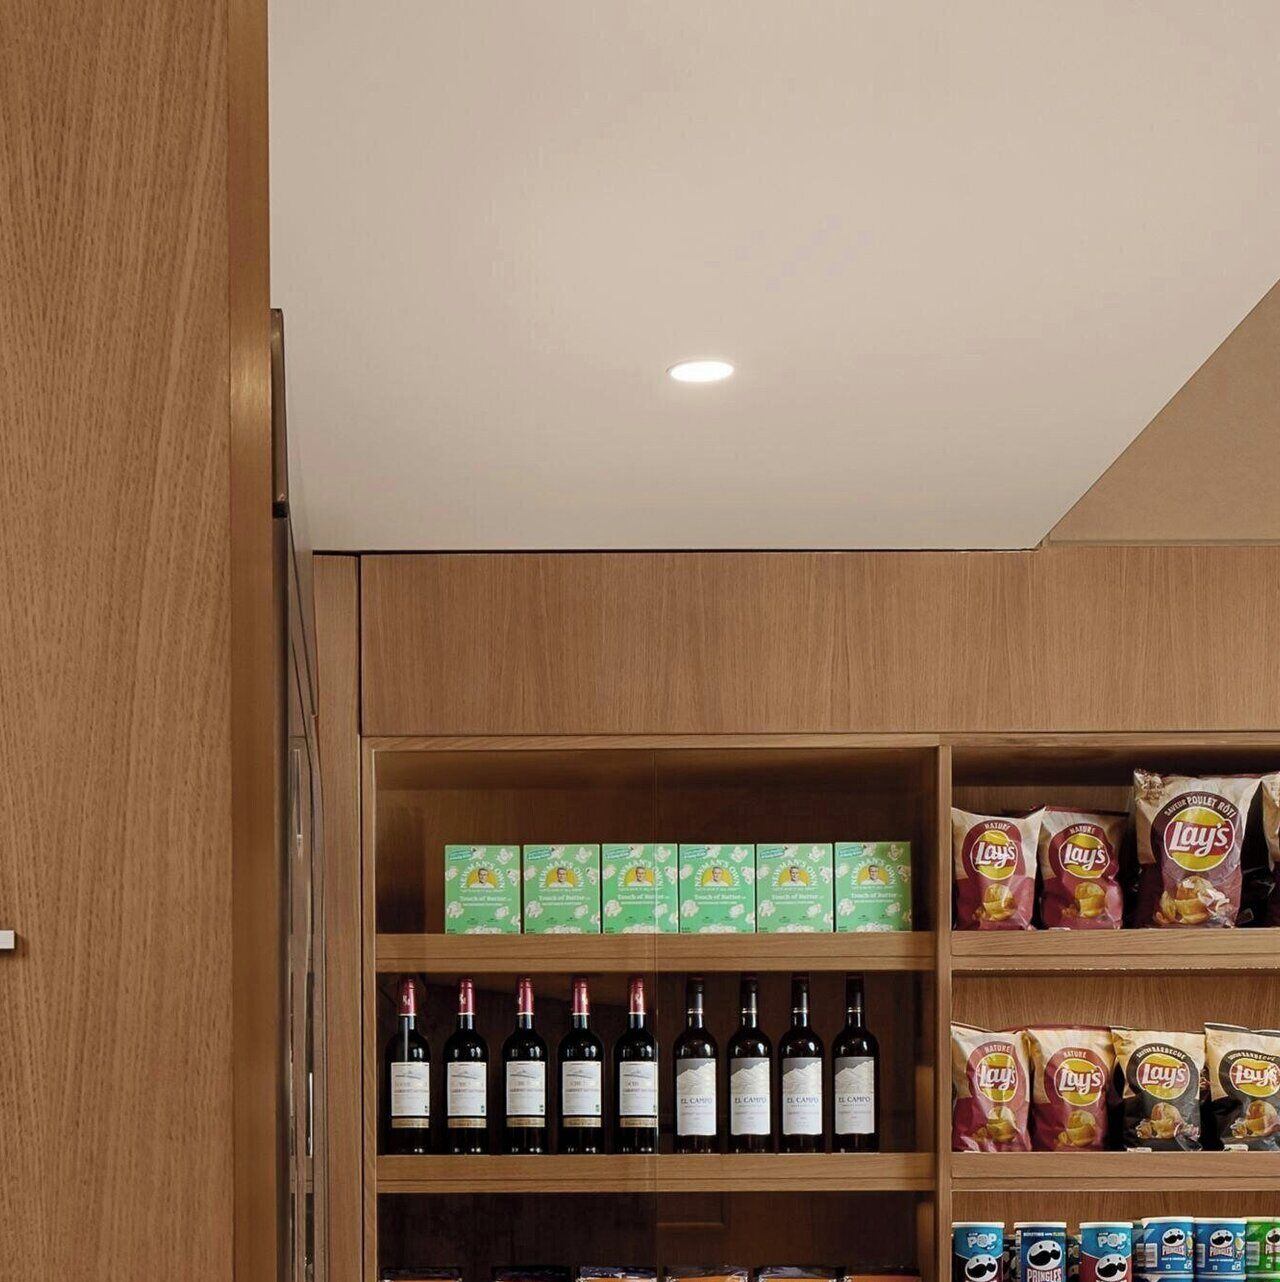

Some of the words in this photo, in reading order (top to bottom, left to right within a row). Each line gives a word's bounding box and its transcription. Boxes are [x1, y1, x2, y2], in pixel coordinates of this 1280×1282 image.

[1186, 795, 1216, 809] POULET
[984, 822, 1010, 830] NATURE
[1070, 826, 1096, 834] NATURE
[1170, 822, 1230, 856] Lay's
[975, 841, 1016, 868] Lay's
[1064, 844, 1106, 871] Lay's
[985, 1045, 1010, 1054] NATURE
[1064, 1050, 1086, 1058] NATURE
[979, 1065, 1016, 1092] Lay's
[1059, 1068, 1102, 1095] Lay's
[1142, 1064, 1187, 1088] Lay's
[1236, 1064, 1278, 1086] Lay's
[690, 1096, 712, 1104] CAMPO
[744, 1096, 766, 1104] CAMPO
[796, 1096, 818, 1104] CAMPO
